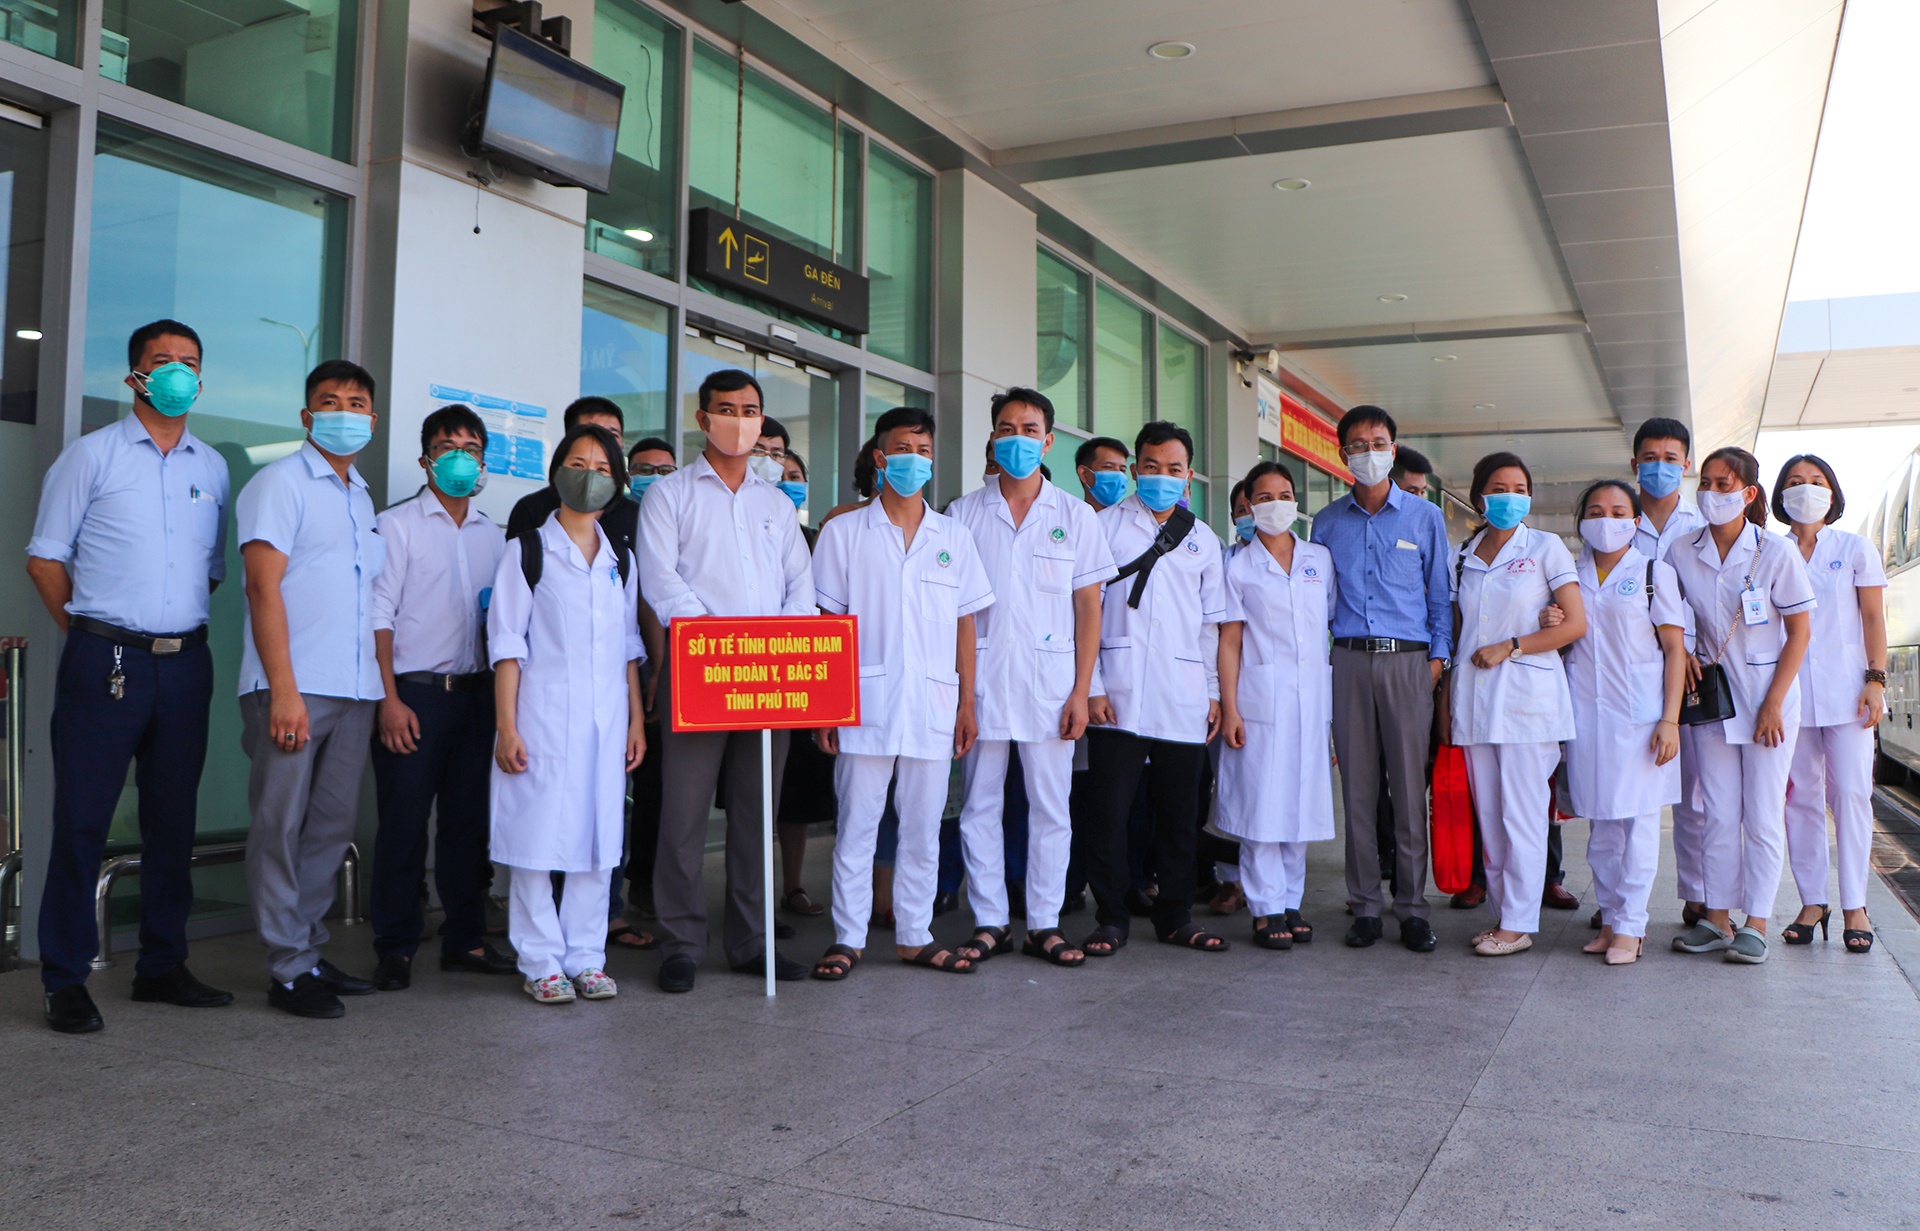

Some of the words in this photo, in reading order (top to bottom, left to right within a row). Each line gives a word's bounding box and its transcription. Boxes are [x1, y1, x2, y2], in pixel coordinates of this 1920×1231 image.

[804, 264, 819, 281] GA
[821, 269, 841, 291] ĐẾN
[688, 633, 706, 655] SỞ
[709, 638, 718, 655] Y
[720, 633, 735, 654] TẾ
[737, 632, 766, 654] TỈNH
[769, 632, 811, 655] QUẢNG
[813, 636, 842, 652] NAM
[704, 662, 731, 682] ĐÓN
[733, 662, 768, 682] ĐOÀN
[771, 664, 781, 683] Y,
[787, 661, 812, 681] BÁC
[815, 661, 828, 680] SĨ
[725, 688, 754, 710] TỈNH
[757, 689, 783, 709] PHÚ
[785, 691, 809, 711] THỌ
